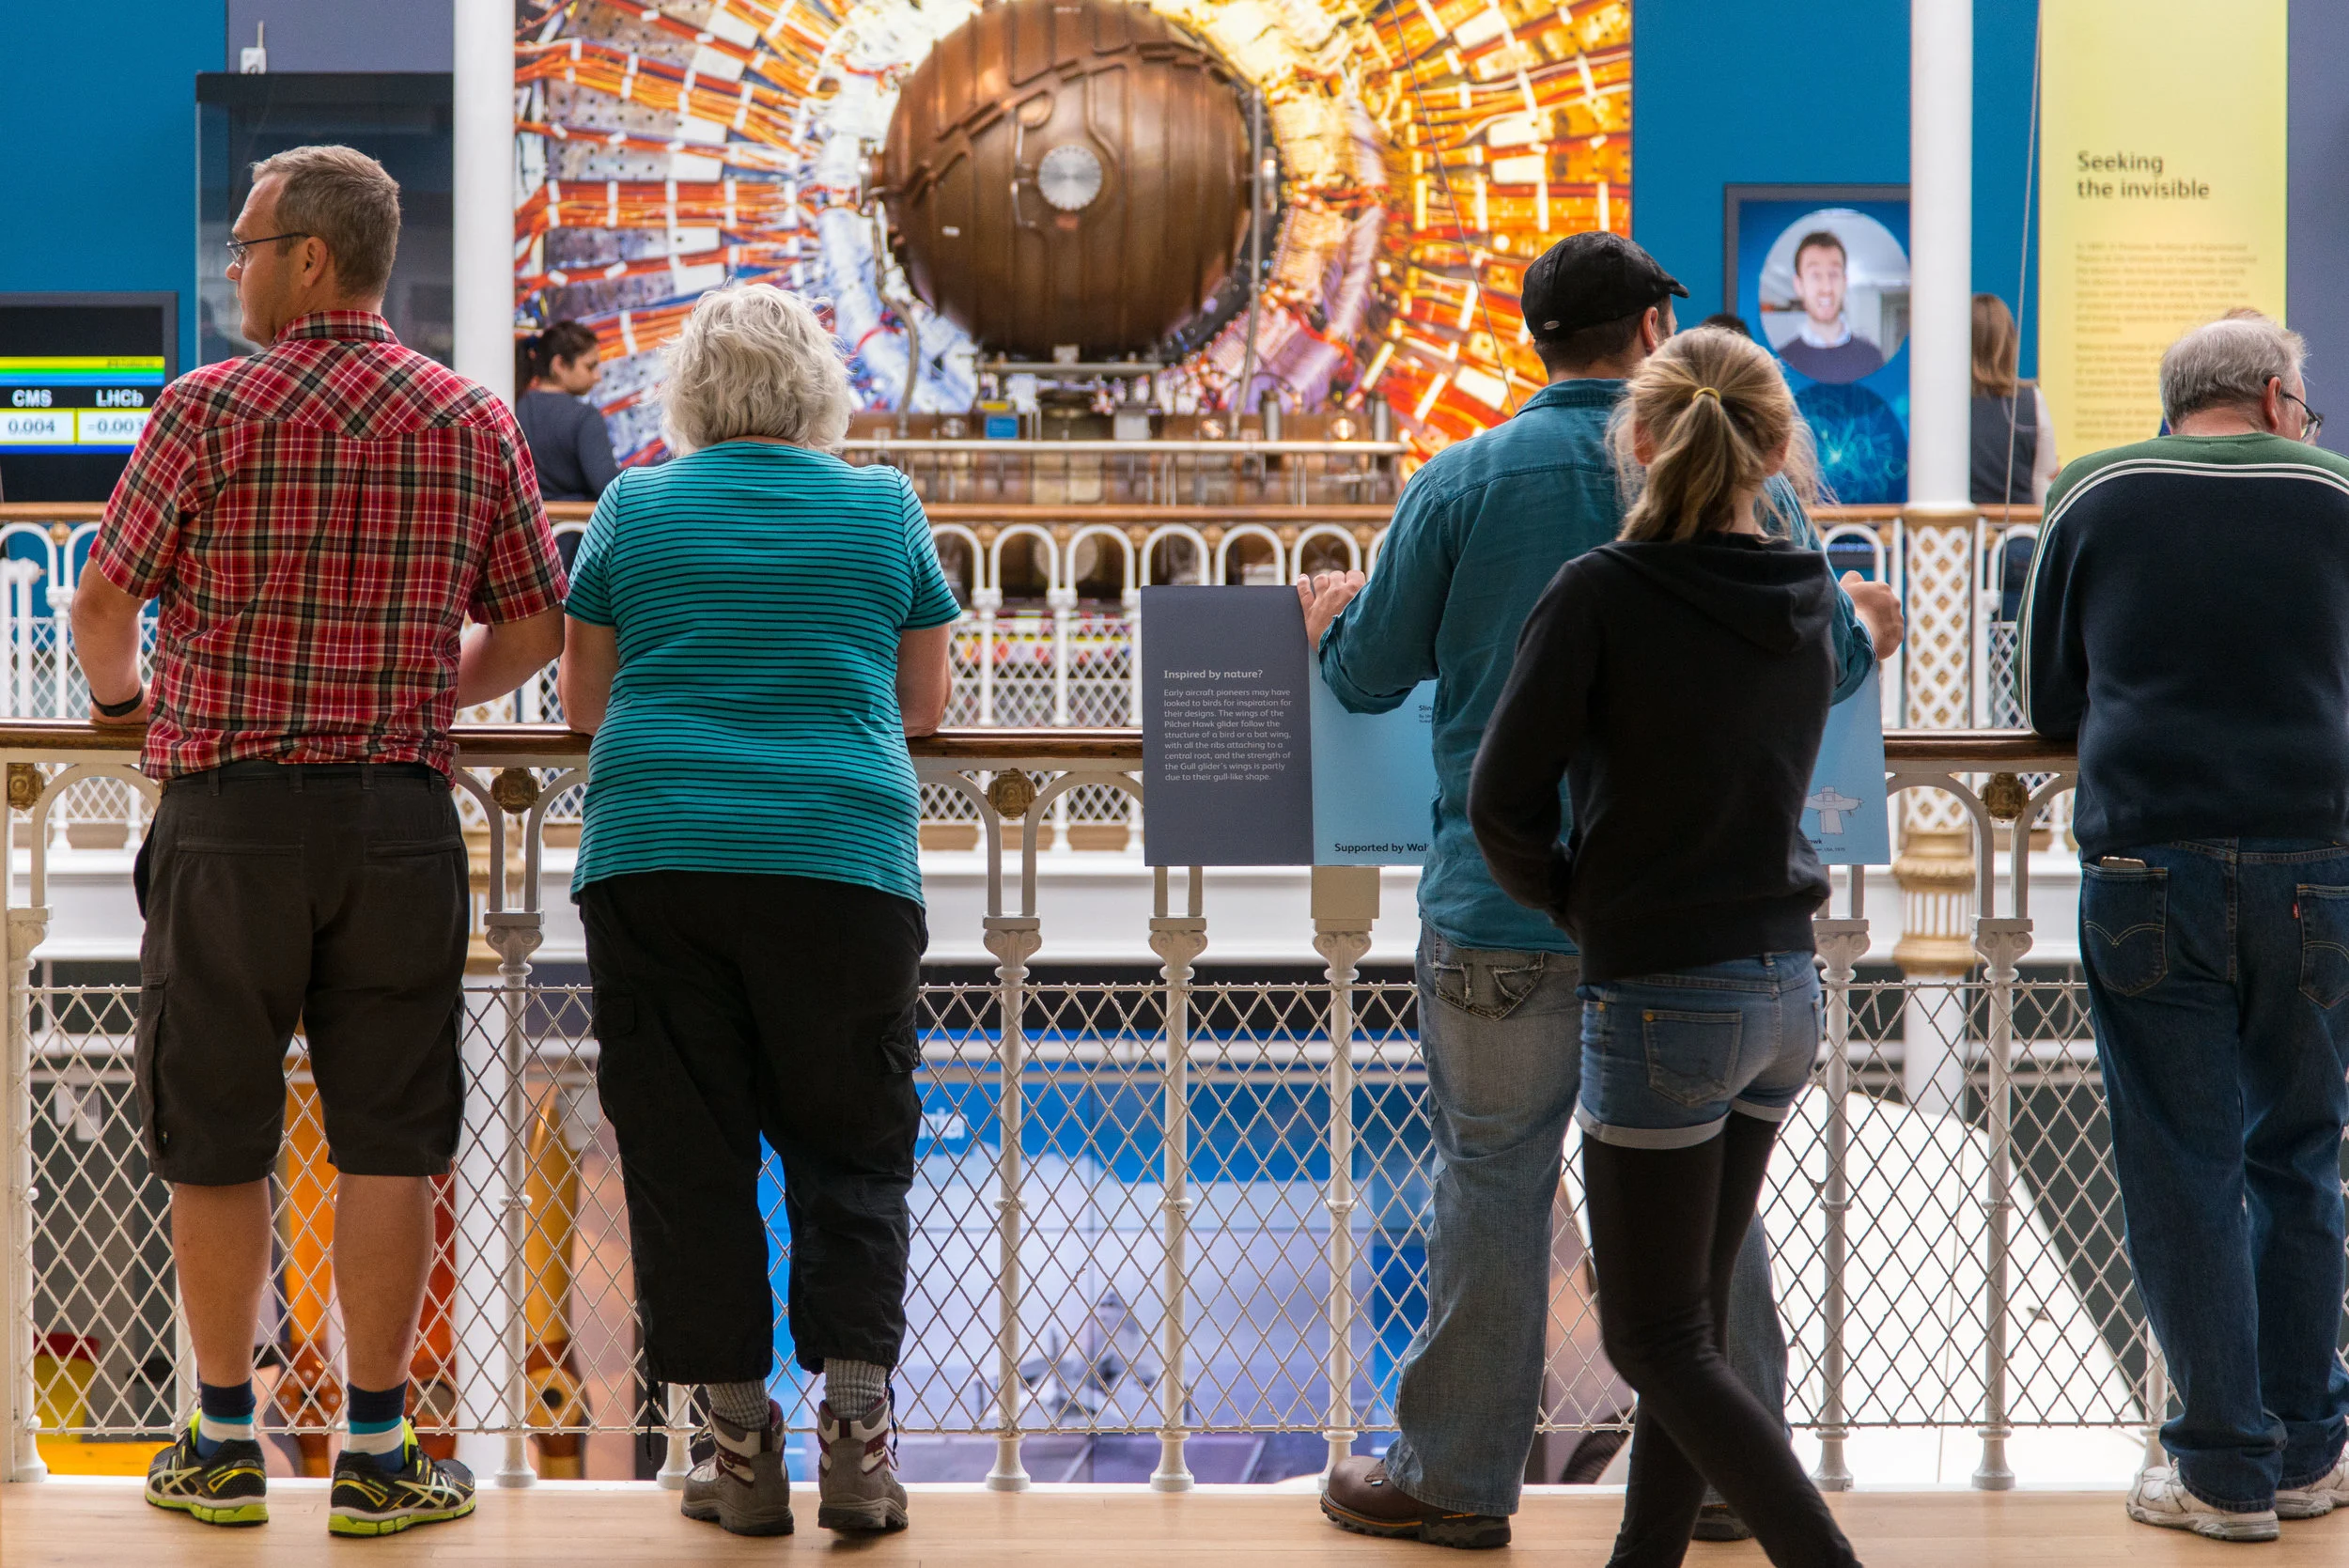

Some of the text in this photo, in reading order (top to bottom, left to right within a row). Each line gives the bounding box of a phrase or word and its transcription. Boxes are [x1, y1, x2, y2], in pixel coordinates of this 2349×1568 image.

[2077, 149, 2165, 175] Seeking
[2077, 179, 2211, 199] the invisible
[11, 389, 53, 407] CMS
[95, 389, 144, 407] LHCb
[8, 417, 55, 435] 0.004
[1164, 669, 1263, 680] Inspired by nature?
[1164, 689, 1184, 698] Early
[1217, 689, 1250, 697] pioneers
[1237, 699, 1278, 707] inspiration
[1280, 698, 1292, 706] for
[1185, 710, 1217, 719] designs.
[1217, 721, 1238, 729] glider
[1226, 741, 1266, 750] attaching
[1247, 752, 1281, 761] strength
[1228, 763, 1252, 771] wings
[1213, 773, 1244, 783] gull-like
[1245, 773, 1271, 782] shape.
[1334, 843, 1429, 854] Supported by Wal
